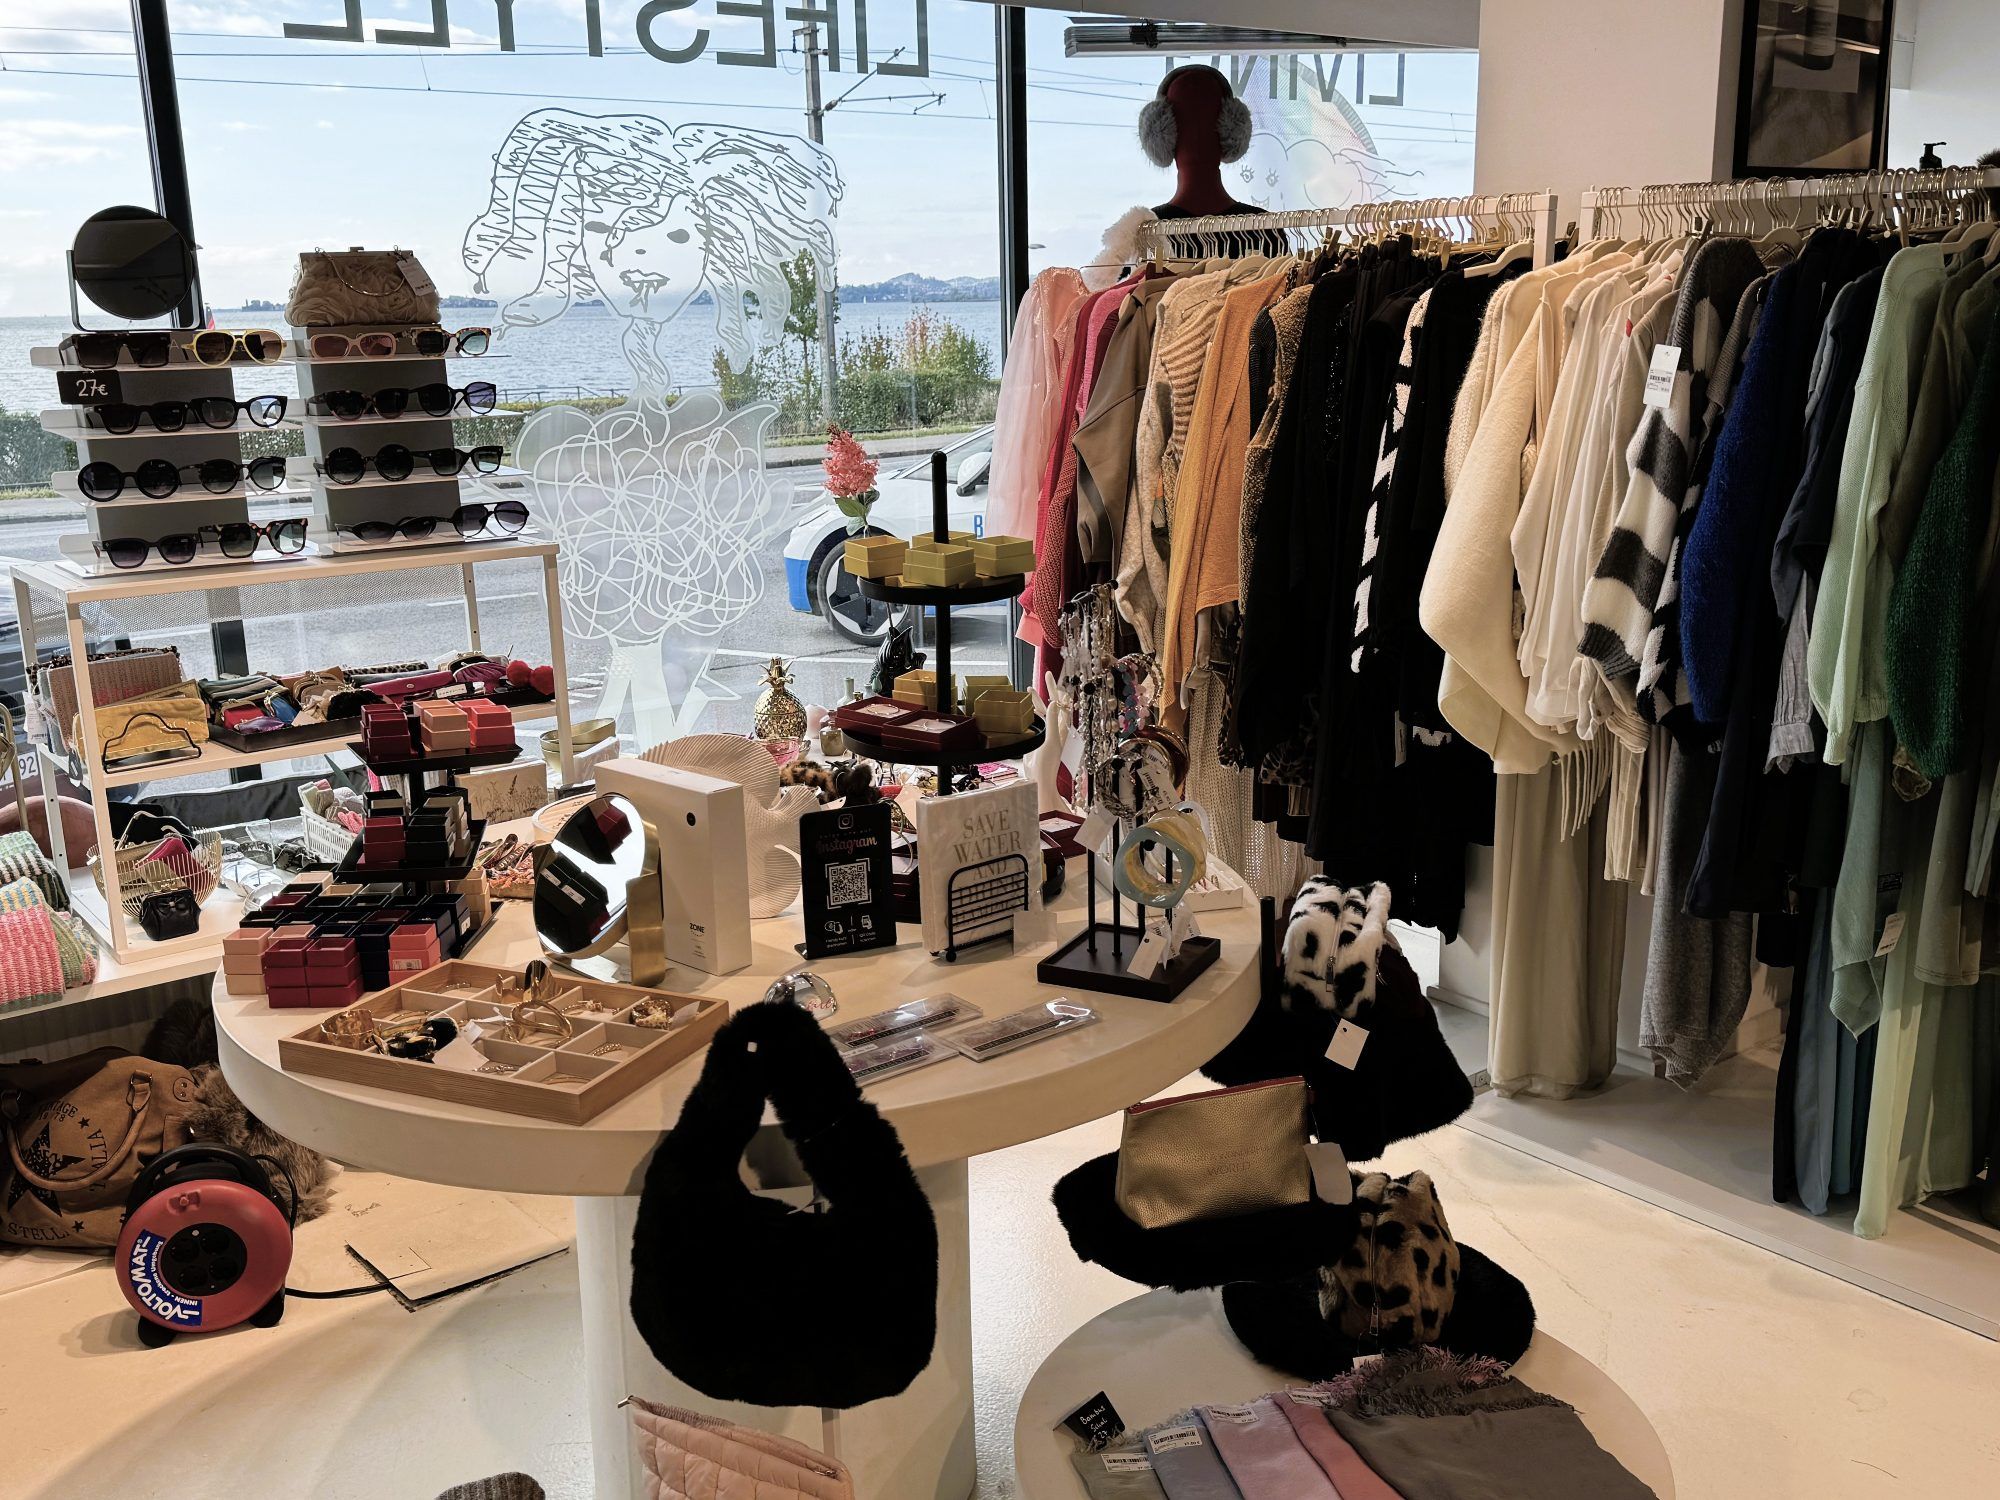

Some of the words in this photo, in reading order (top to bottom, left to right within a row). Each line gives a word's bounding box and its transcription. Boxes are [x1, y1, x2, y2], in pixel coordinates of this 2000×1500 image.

[75, 379, 108, 397] 27€
[963, 809, 1010, 839] SAVE
[954, 830, 1022, 864] WATER
[689, 922, 705, 934] ZONE
[8, 1222, 70, 1241] STELL
[174, 1296, 198, 1307] INNEN
[1079, 1404, 1106, 1425] Bambus
